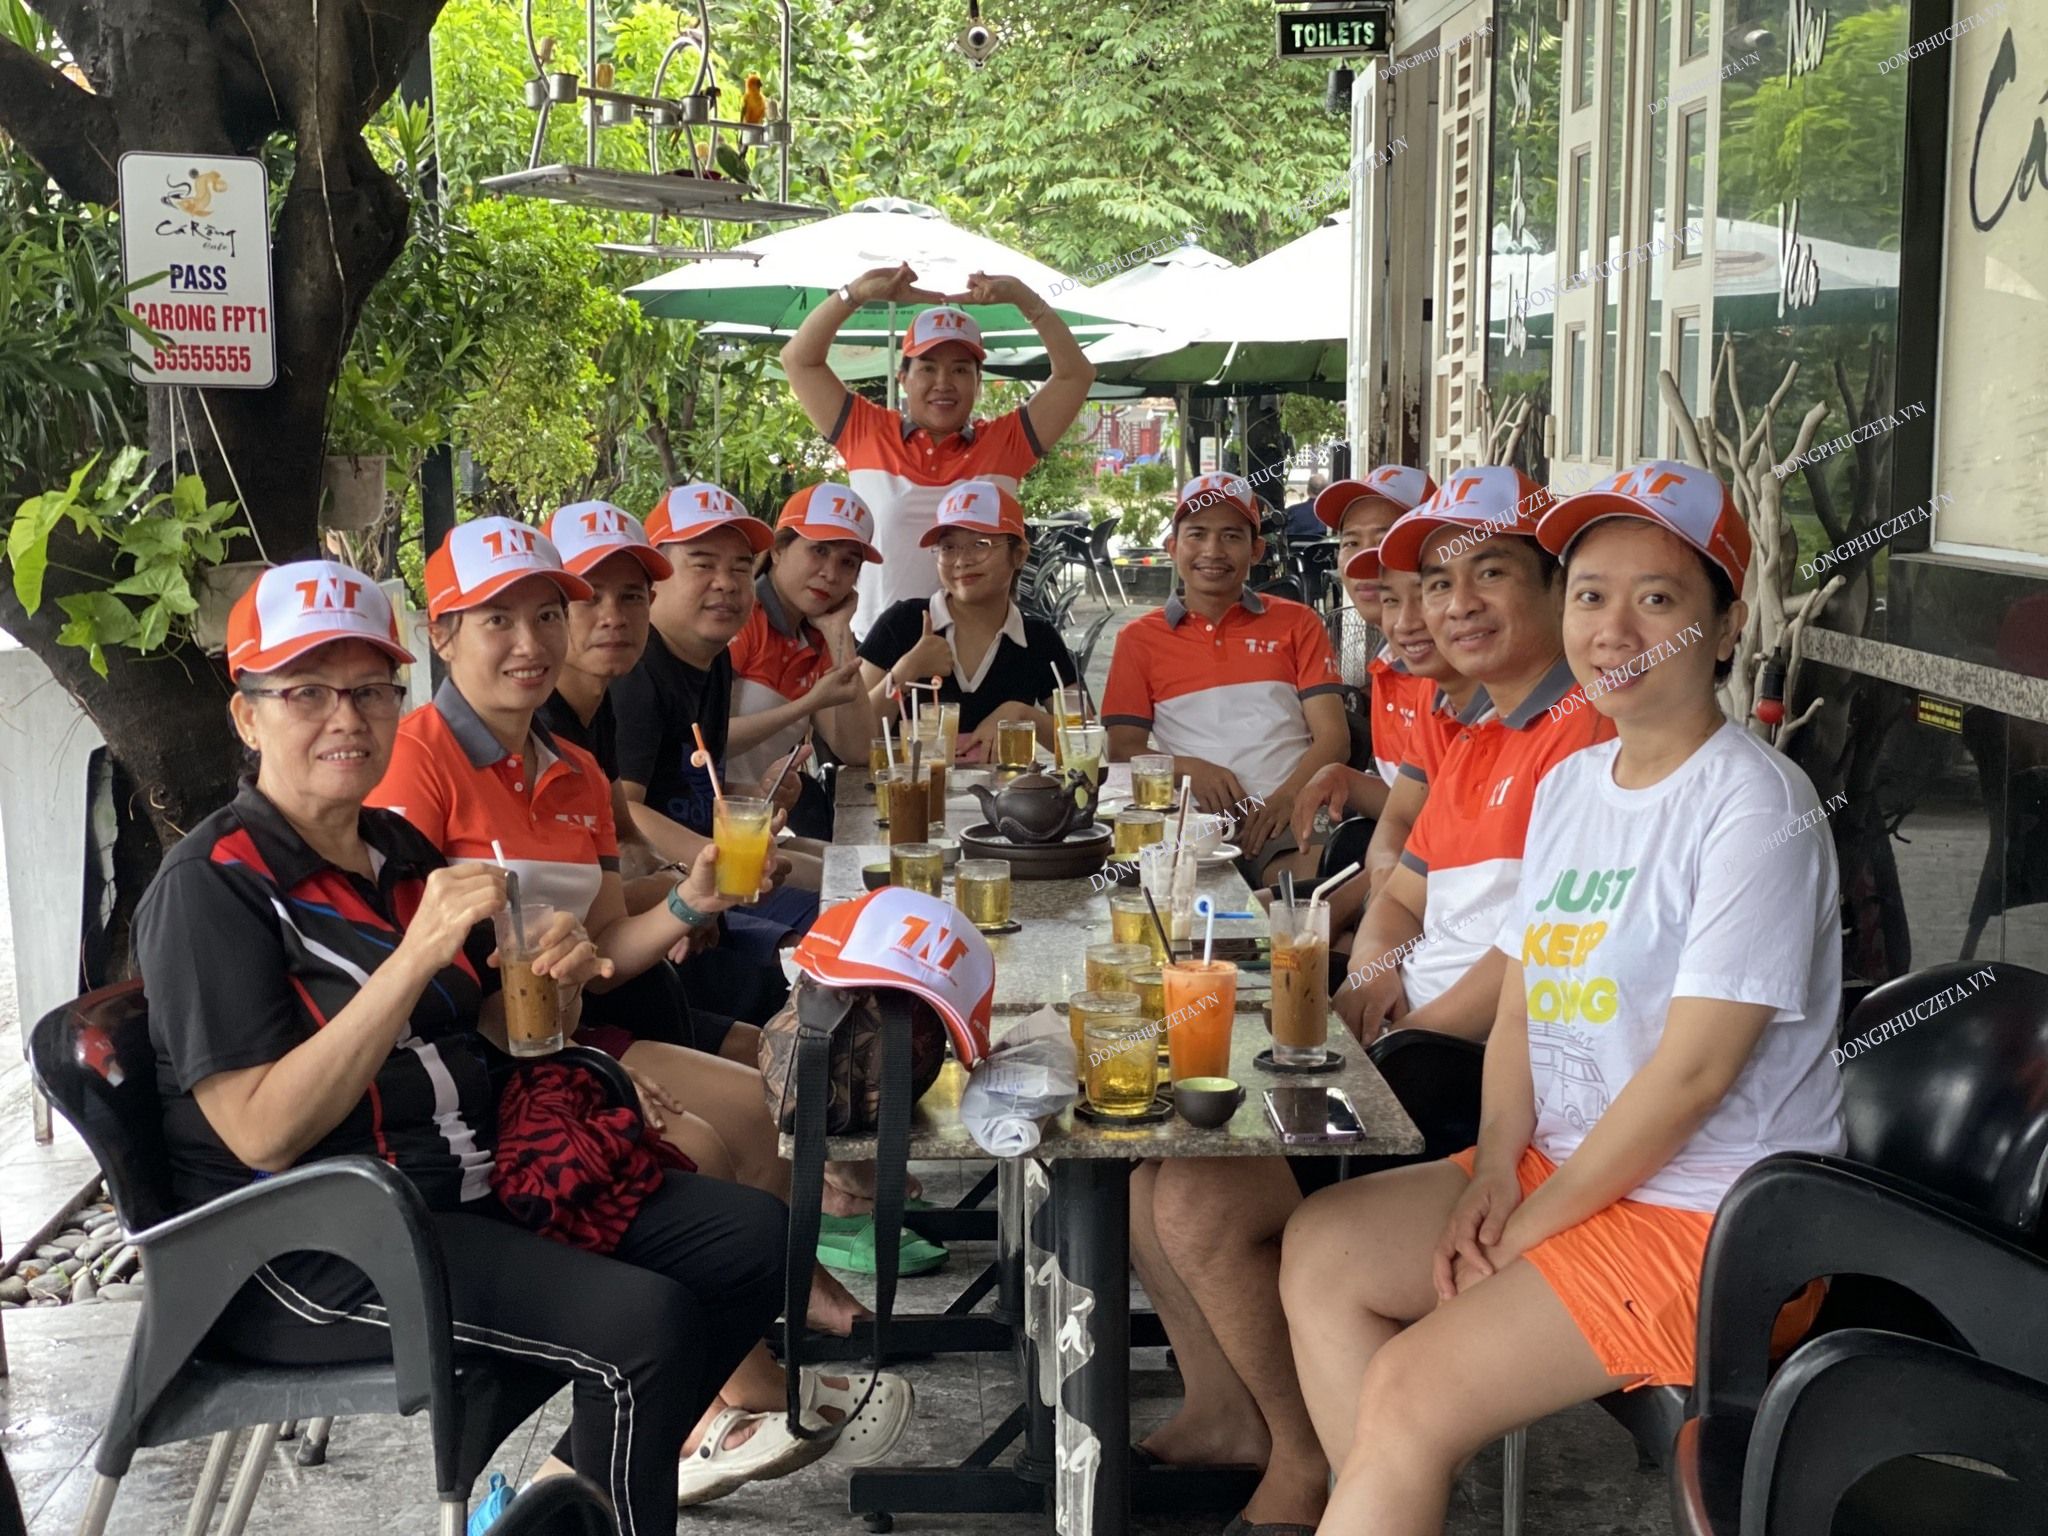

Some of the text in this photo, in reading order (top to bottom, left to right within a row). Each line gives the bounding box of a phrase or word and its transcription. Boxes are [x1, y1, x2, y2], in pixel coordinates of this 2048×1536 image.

[169, 263, 227, 290] PASS
[133, 302, 267, 334] CARONG FPT1
[154, 344, 251, 372] 55555555
[1535, 866, 1637, 914] JUST
